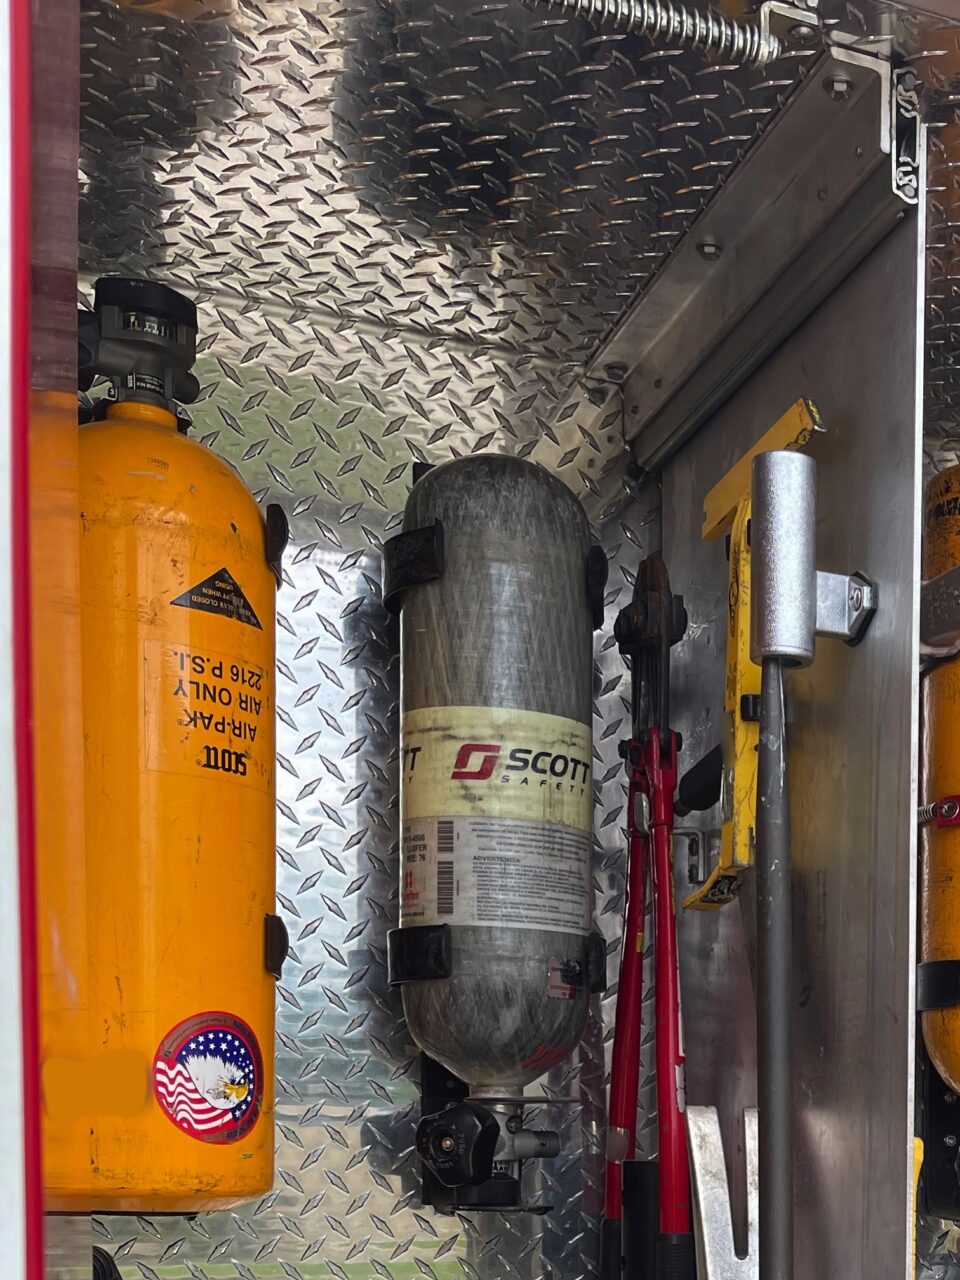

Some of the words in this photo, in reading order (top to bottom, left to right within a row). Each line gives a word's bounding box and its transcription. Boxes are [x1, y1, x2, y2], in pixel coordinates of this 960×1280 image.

[192, 595, 218, 606] CLOSED
[173, 651, 223, 679] P.S.I.
[230, 664, 262, 691] 2216
[173, 679, 232, 706] ONLY
[239, 692, 261, 716] AIR
[183, 709, 256, 742] AIR-PAK
[202, 745, 247, 776] SCOTT
[506, 748, 590, 785] SCOTT
[501, 775, 585, 797] SAFETY
